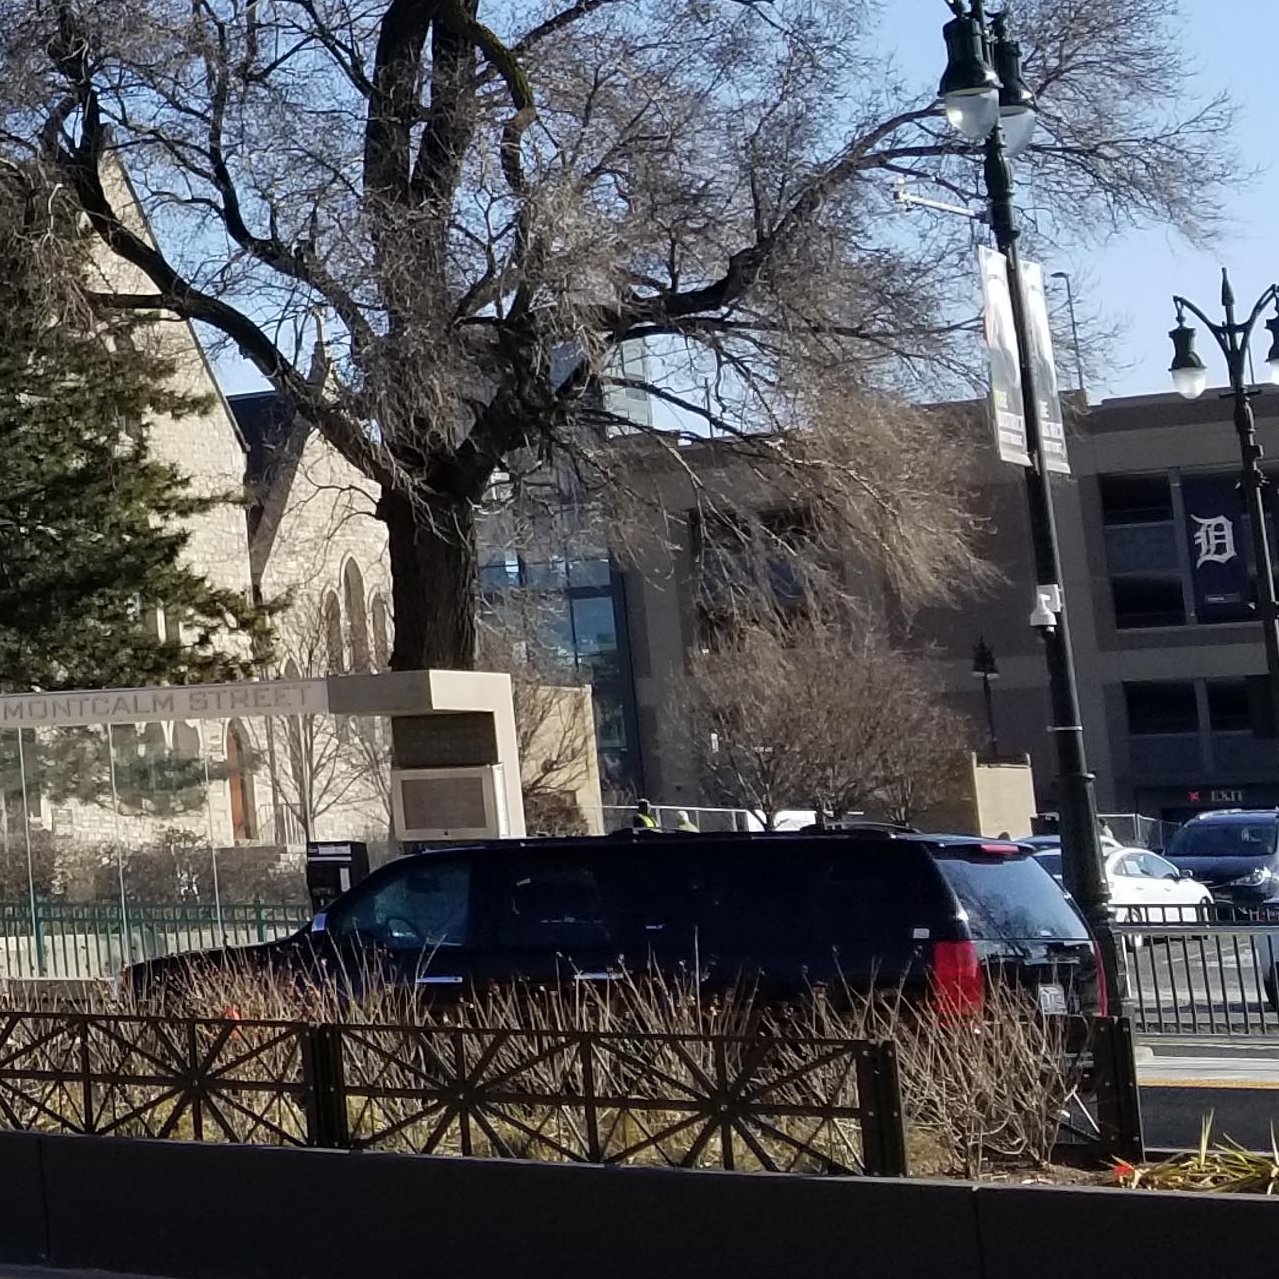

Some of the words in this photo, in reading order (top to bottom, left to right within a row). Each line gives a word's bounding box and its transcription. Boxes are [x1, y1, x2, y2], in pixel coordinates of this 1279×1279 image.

[1190, 514, 1237, 569] D
[3, 693, 174, 721] MONTCALM
[189, 684, 311, 711] STREET
[1210, 790, 1243, 802] EXIT
